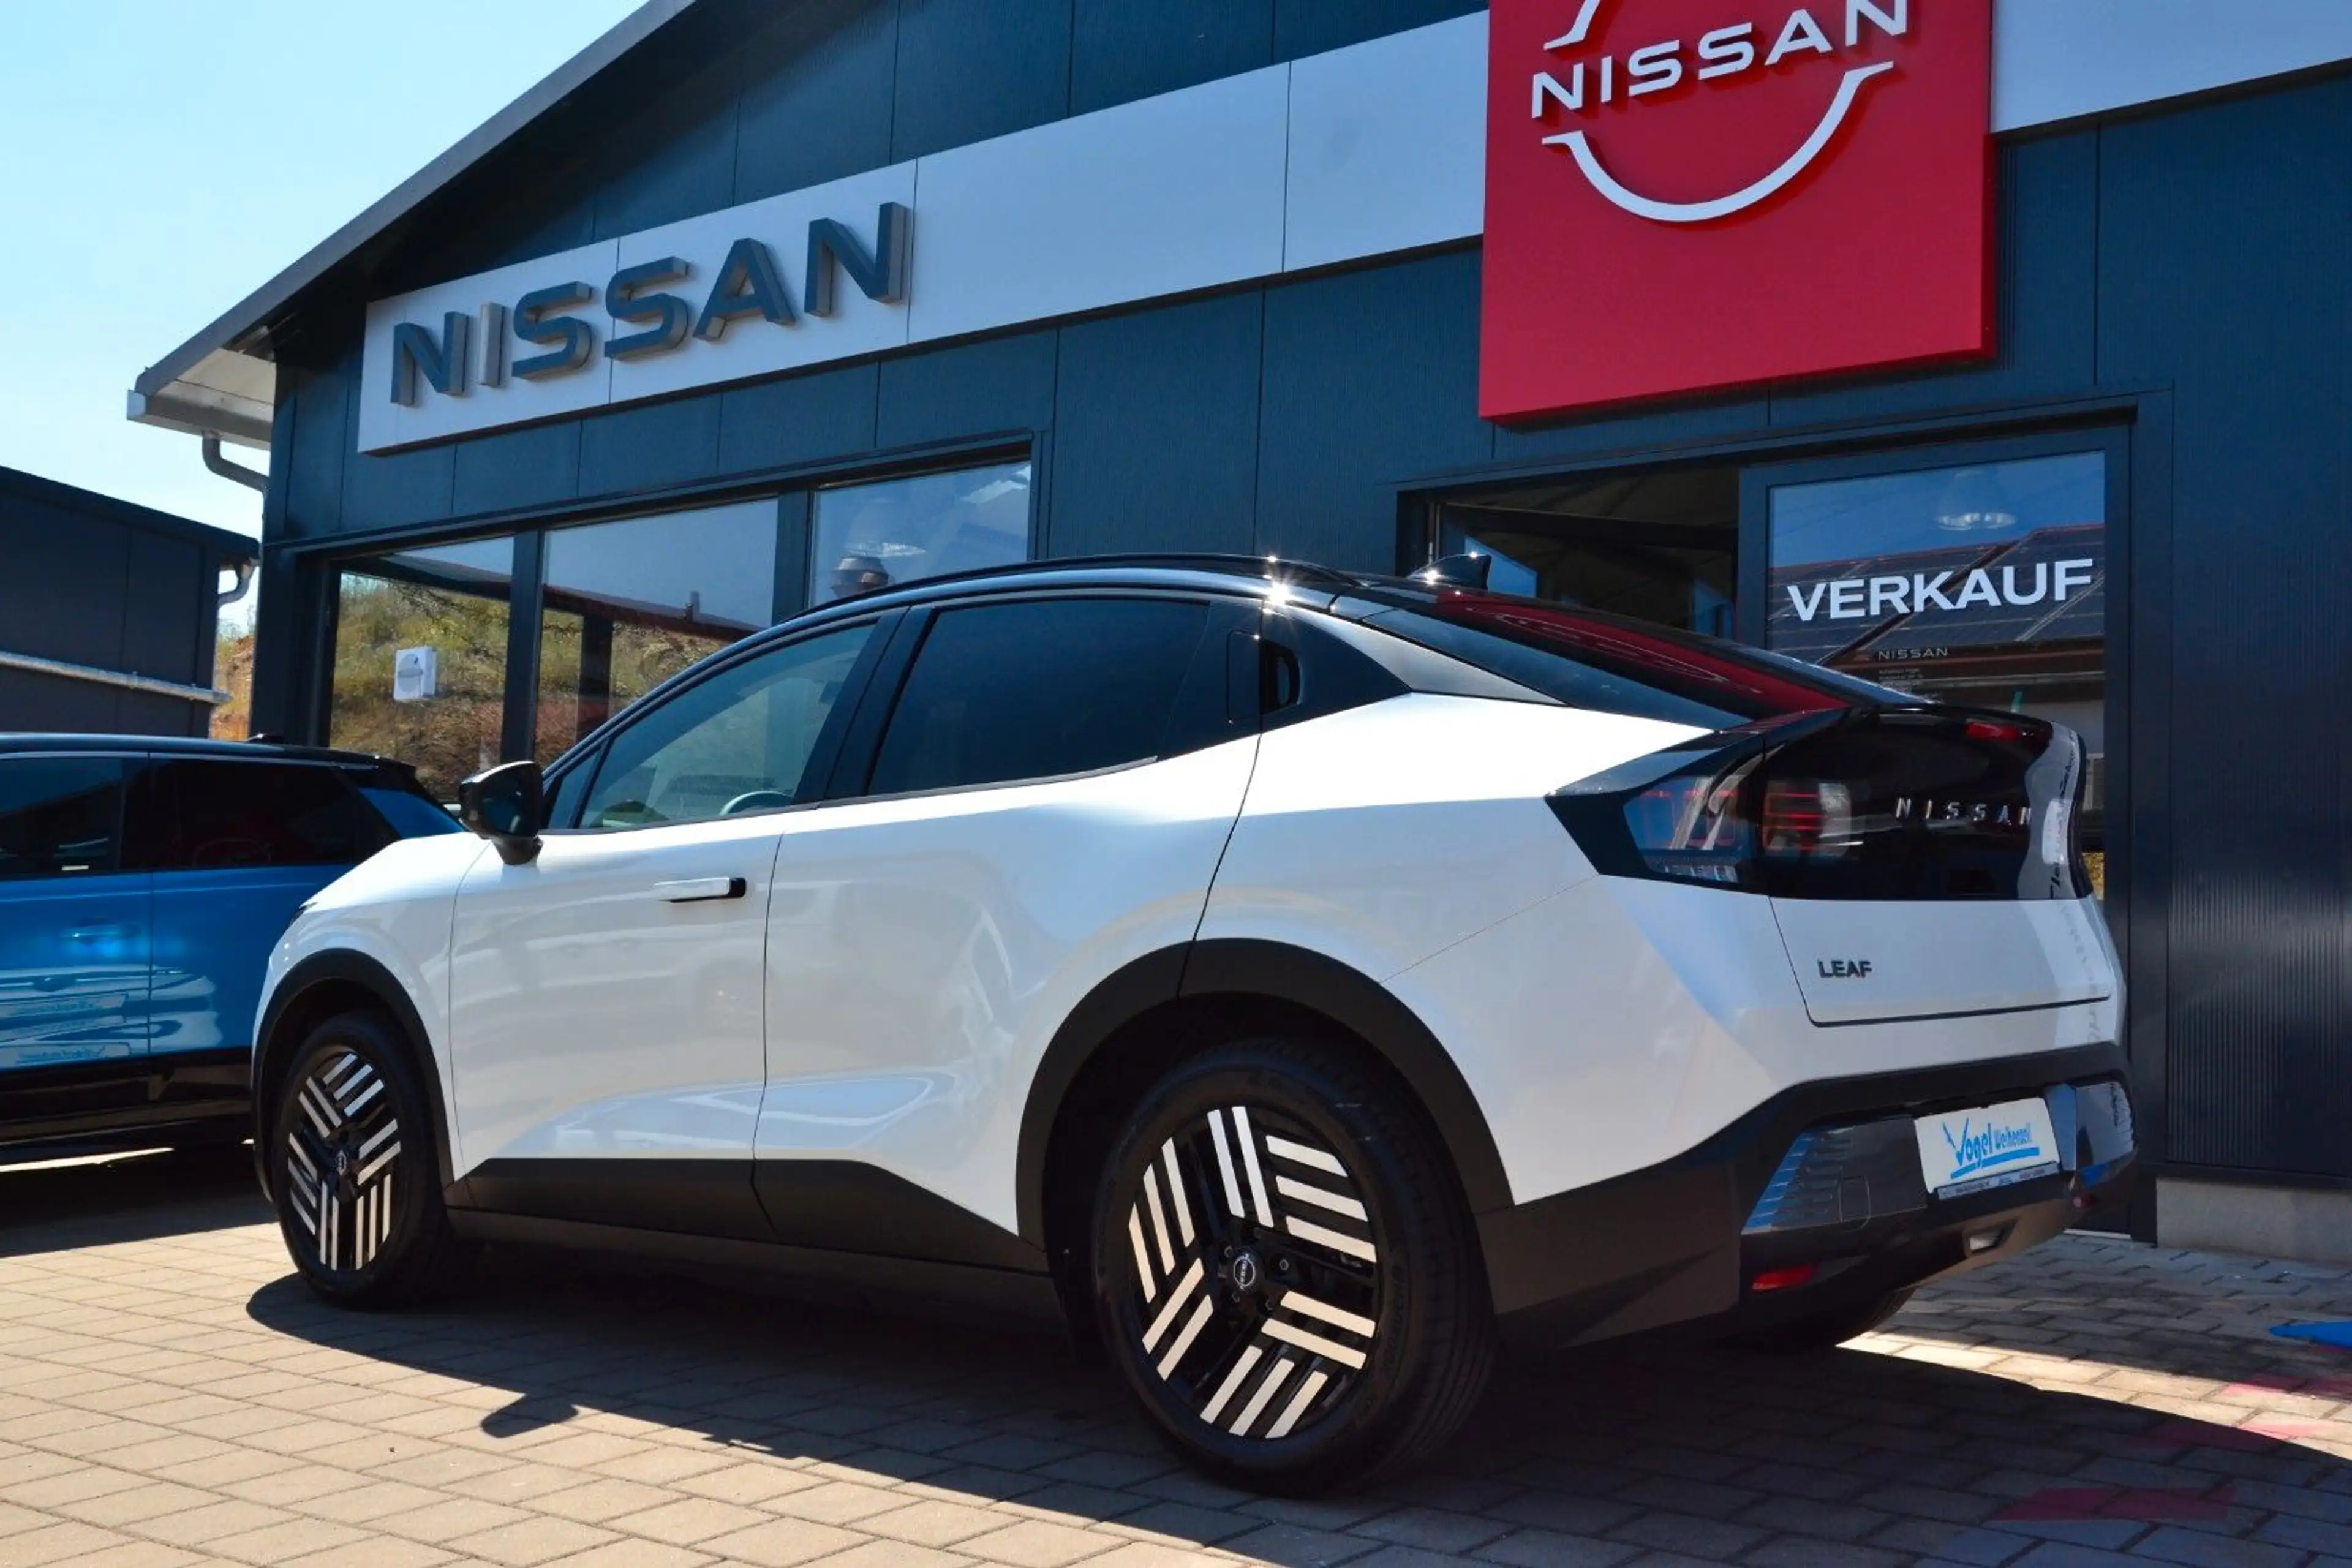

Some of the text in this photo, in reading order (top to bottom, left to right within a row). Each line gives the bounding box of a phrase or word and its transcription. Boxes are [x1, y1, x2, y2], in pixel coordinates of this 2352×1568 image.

[1532, 0, 1907, 119] NISSAN
[390, 202, 907, 406] NISSAN
[1787, 559, 2093, 622] VERKAUF
[1878, 647, 1948, 660] NISSAN
[1896, 797, 2032, 826] NISSAN
[1817, 960, 1872, 978] LEAF
[1942, 1117, 1993, 1168] Vogel
